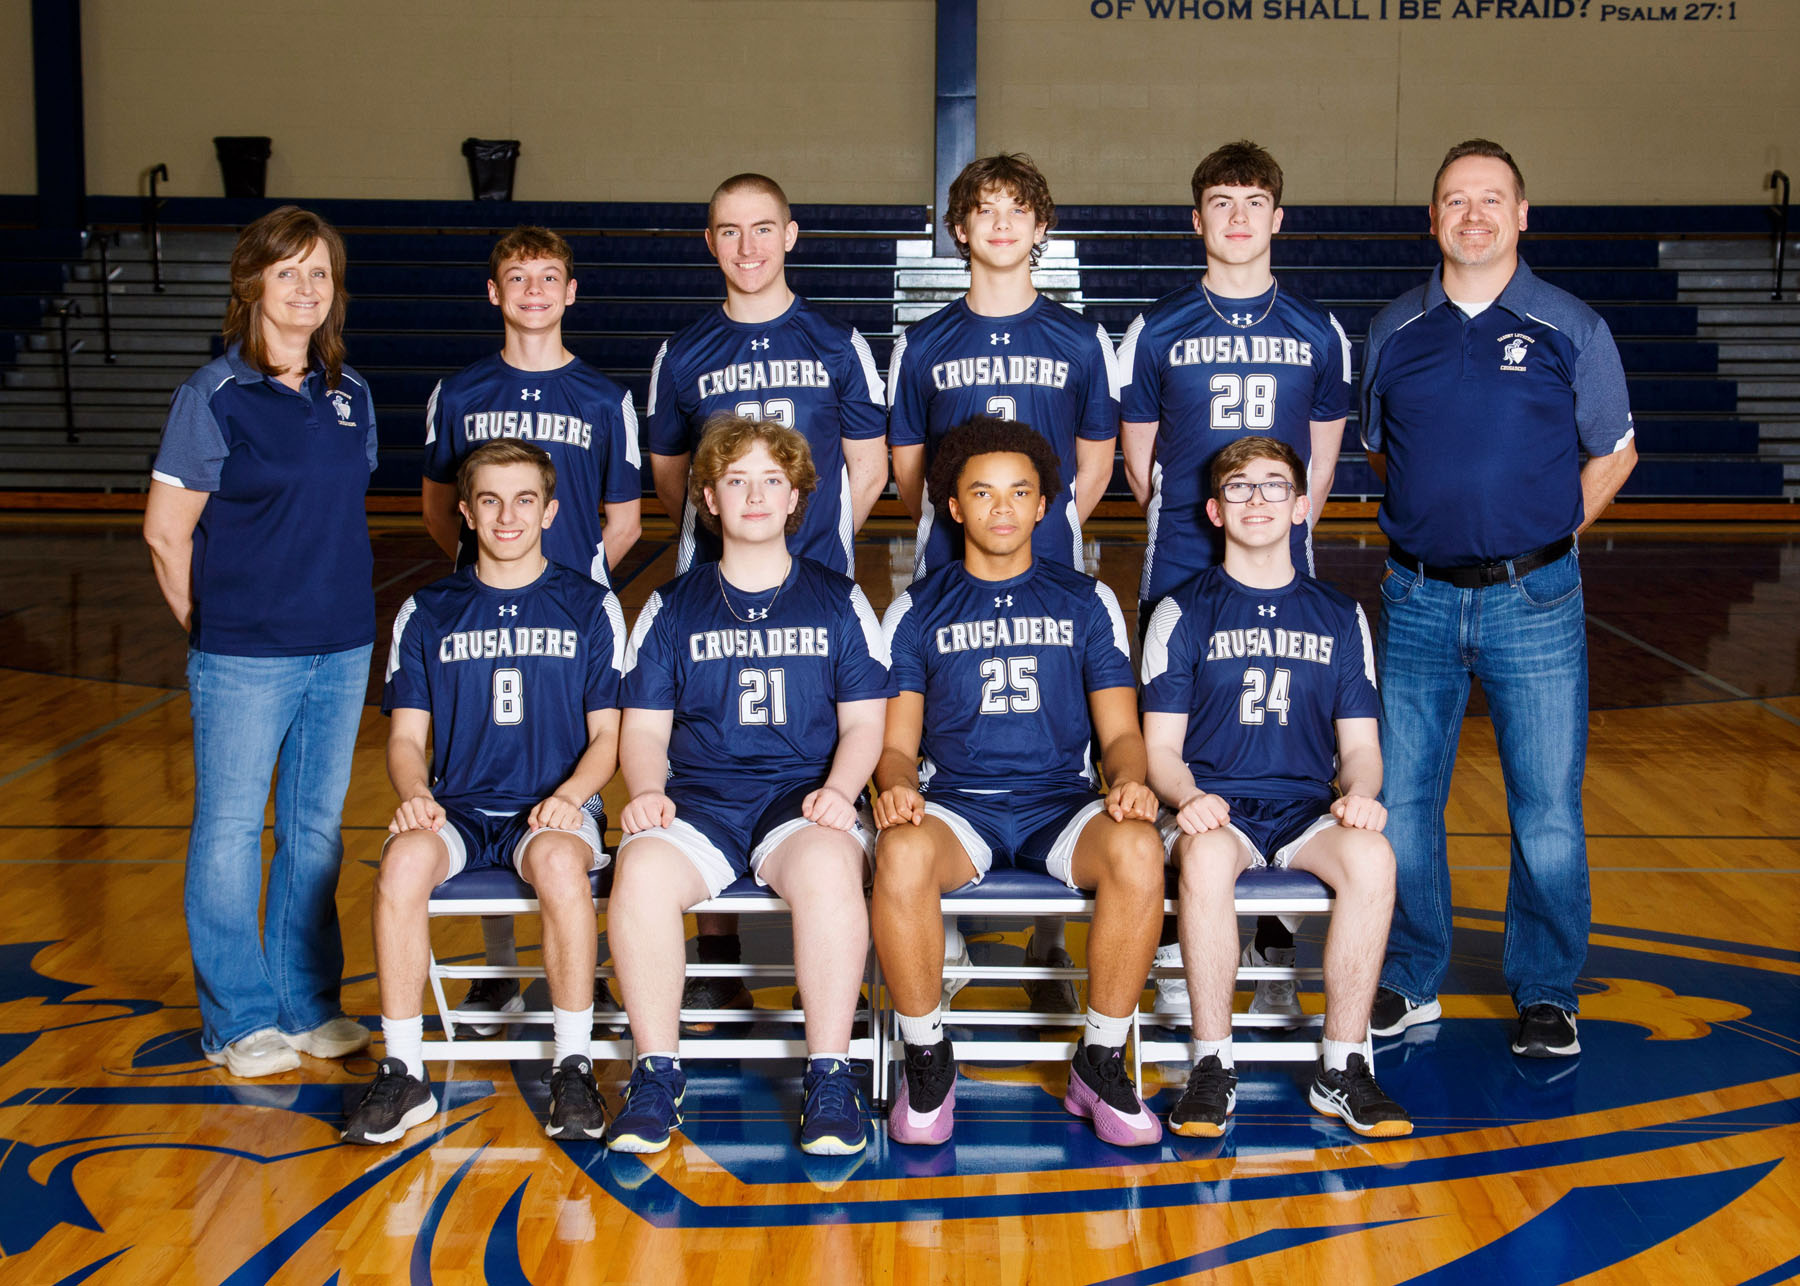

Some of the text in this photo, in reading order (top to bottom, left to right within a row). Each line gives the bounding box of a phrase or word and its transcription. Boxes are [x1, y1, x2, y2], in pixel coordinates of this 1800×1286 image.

[1090, 0, 1135, 19] OF
[1145, 0, 1252, 20] WHOM
[1263, 0, 1369, 20] SHALL
[1379, 0, 1388, 20] I
[1398, 0, 1441, 20] BE
[1451, 0, 1592, 19] AFRAID?
[1683, 2, 1737, 21] 27:1
[1168, 335, 1313, 367] CRUSADERS
[697, 359, 830, 400] CRUSADERS
[931, 356, 1070, 392] CRUSADERS
[1209, 373, 1277, 430] 28
[464, 410, 593, 451] CRUSADERS
[439, 627, 577, 664] CRUSADERS
[690, 626, 829, 663] CRUSADERS
[936, 616, 1074, 655] CRUSADERS
[492, 667, 524, 726] 8
[738, 667, 787, 726] 21
[979, 655, 1041, 715] 25
[1239, 667, 1292, 726] 24
